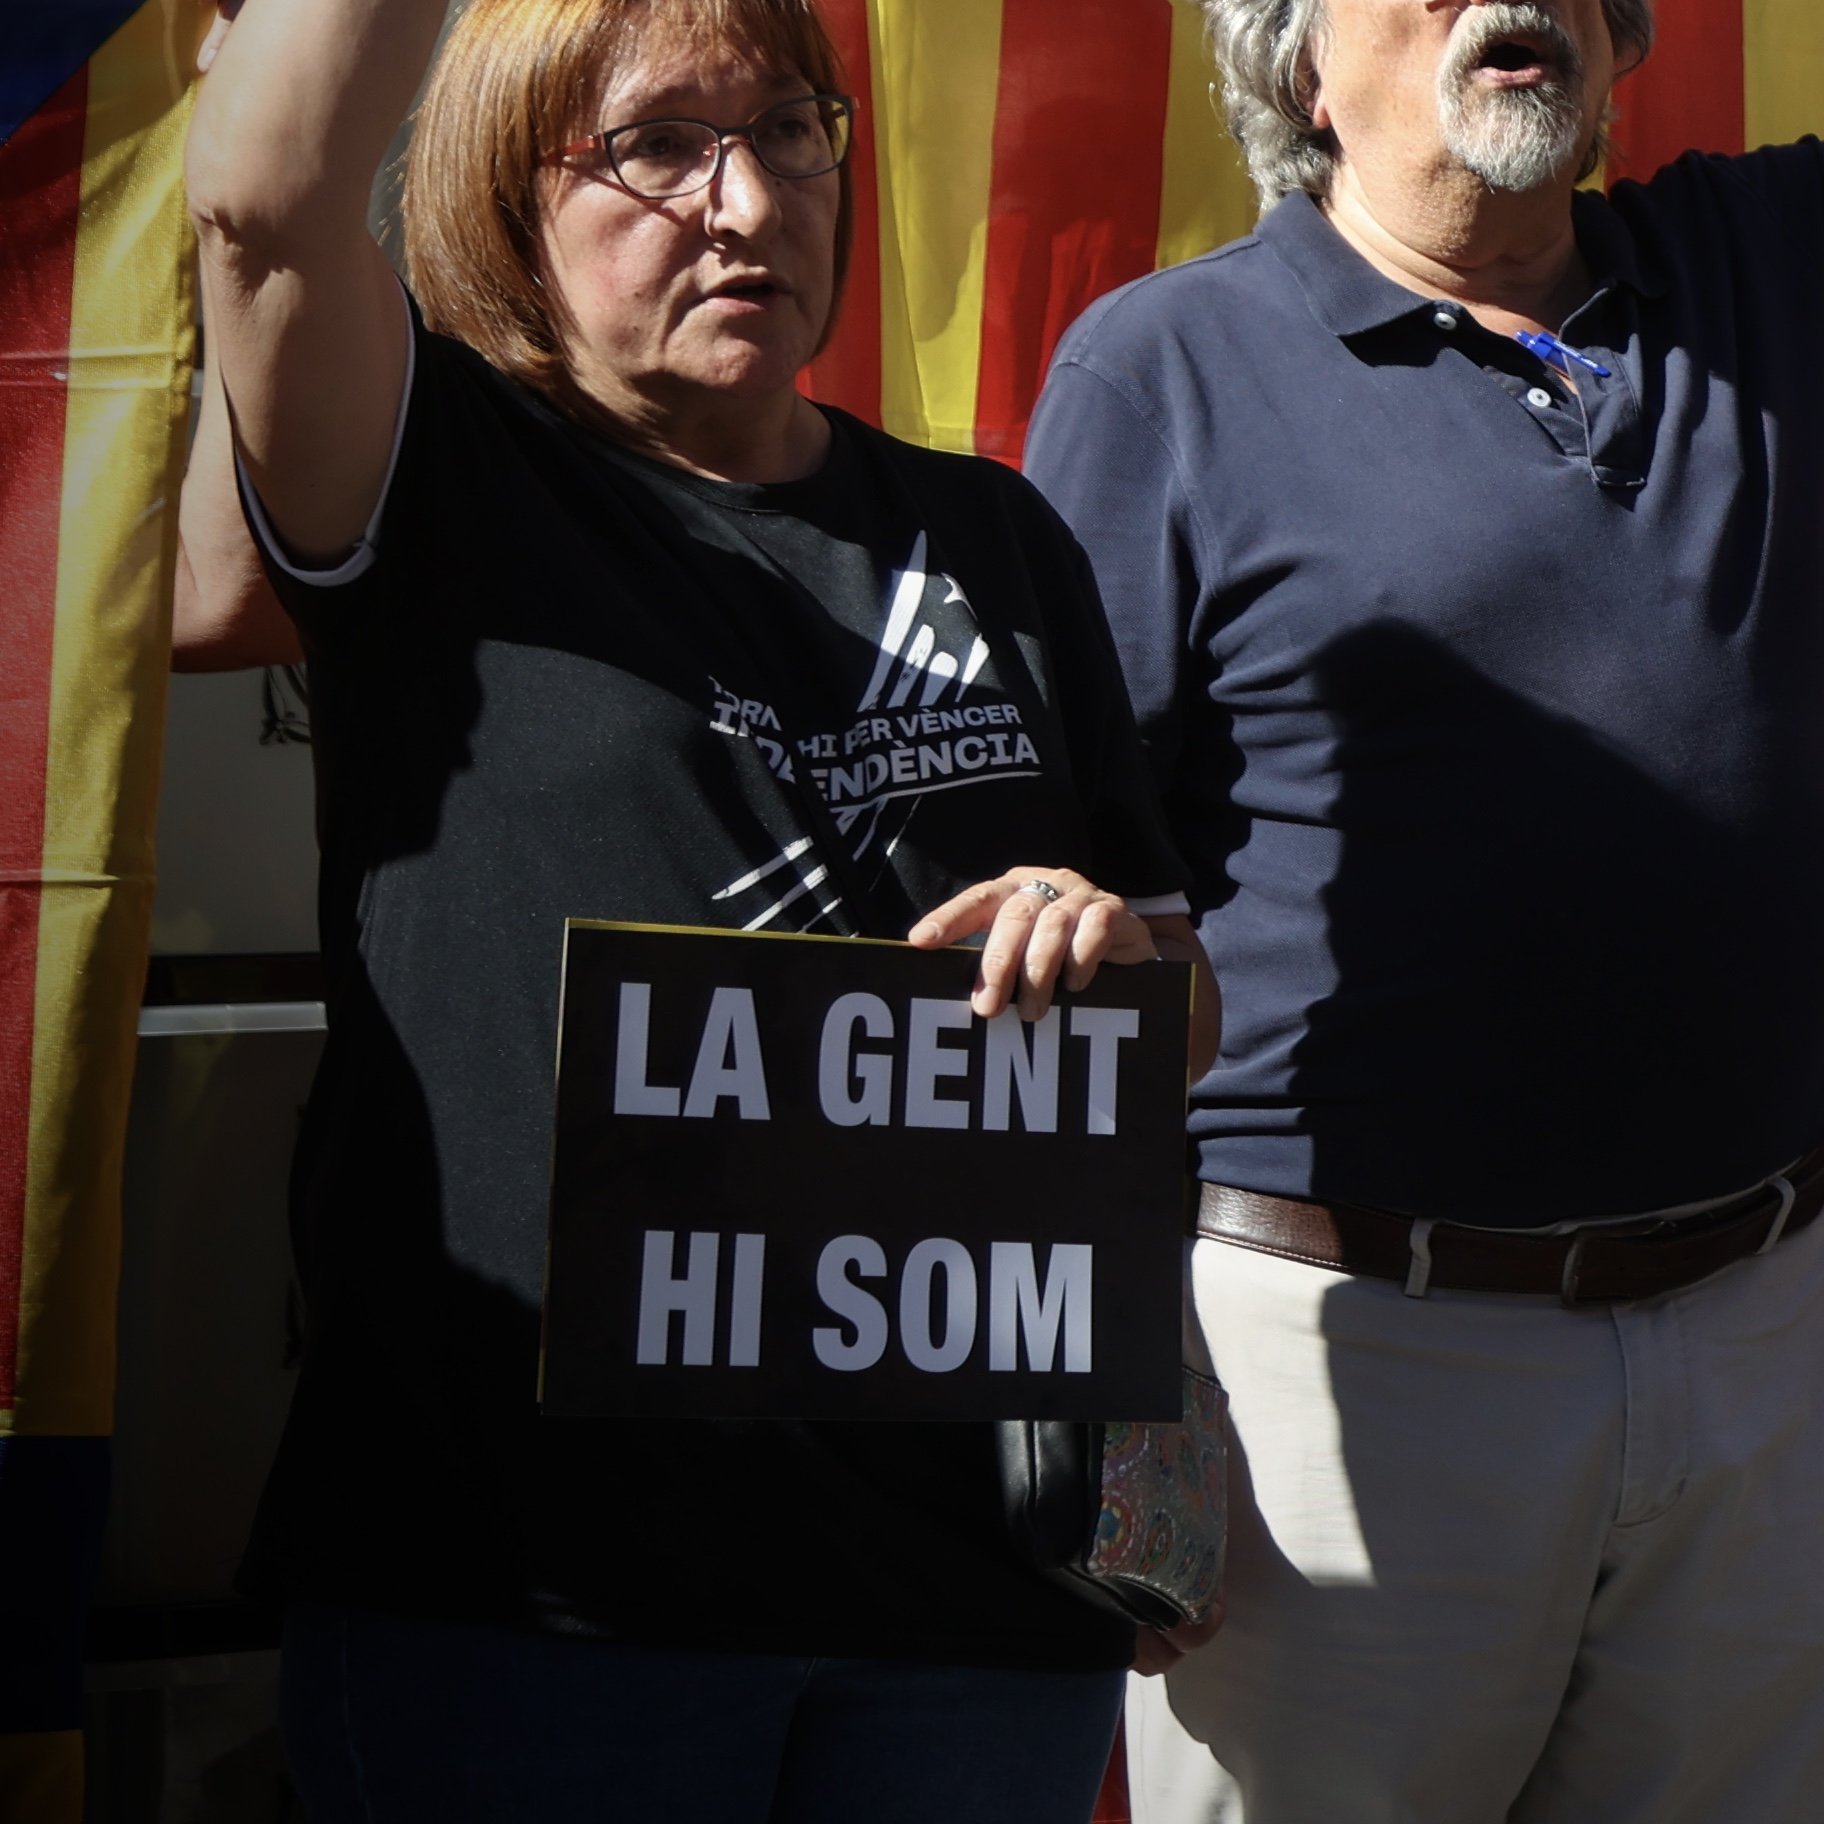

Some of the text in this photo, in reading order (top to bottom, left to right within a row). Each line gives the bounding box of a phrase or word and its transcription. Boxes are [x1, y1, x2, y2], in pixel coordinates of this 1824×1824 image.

[897, 704, 1023, 739] VÈNCER
[613, 982, 1140, 1136] LA GENT
[636, 1230, 1093, 1374] HI SOM
